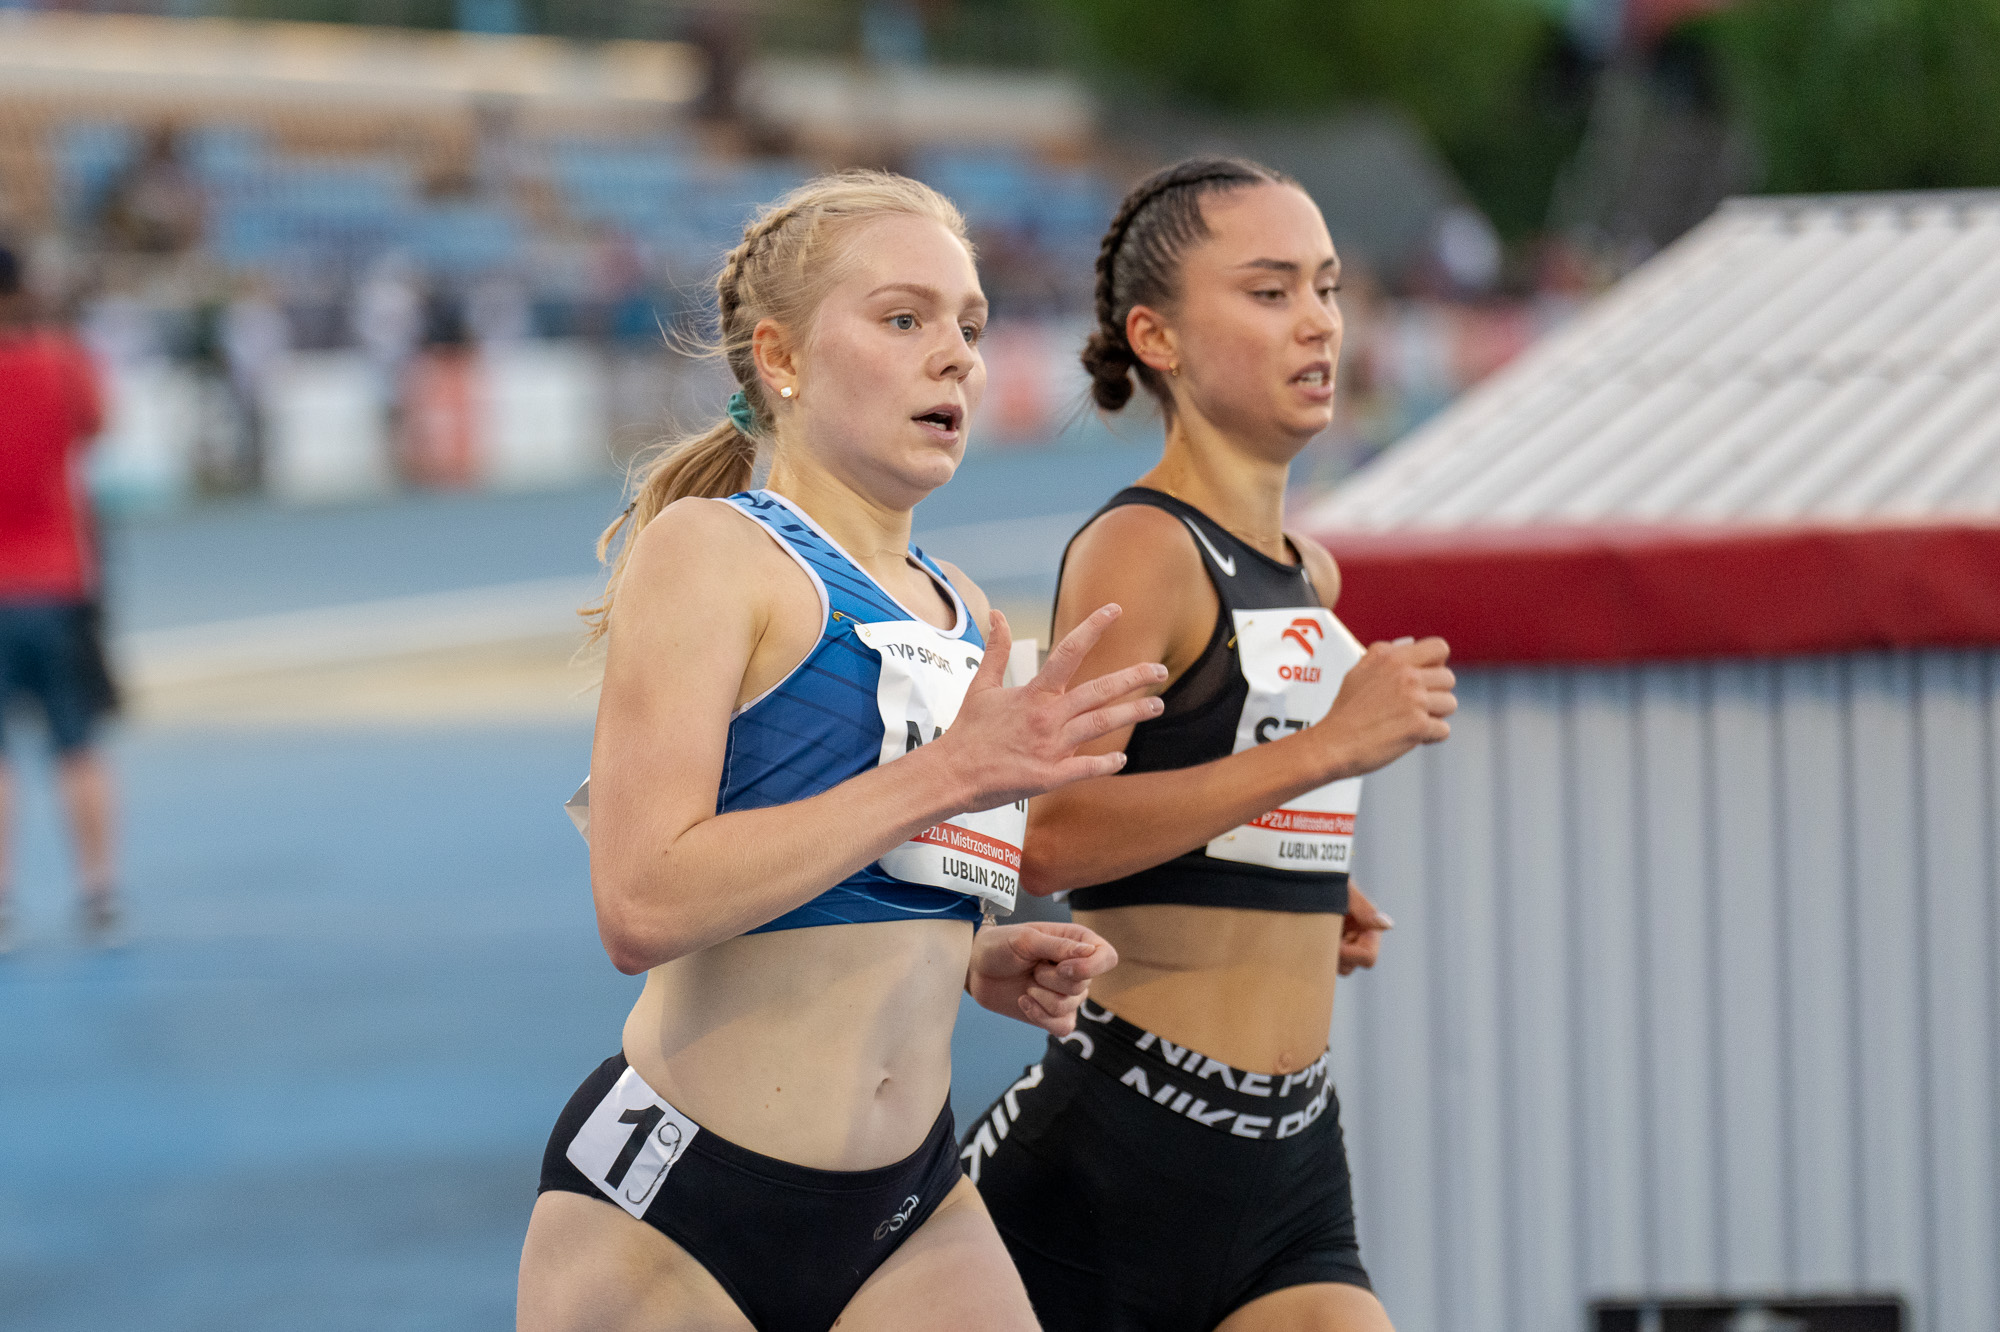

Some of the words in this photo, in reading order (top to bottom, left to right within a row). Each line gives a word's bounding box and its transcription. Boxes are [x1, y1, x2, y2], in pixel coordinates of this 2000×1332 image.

[881, 644, 914, 660] TVP
[917, 646, 953, 675] SPORT
[950, 831, 1004, 861] Mistrzostwa
[1278, 841, 1318, 860] LUBLIN
[1321, 843, 1347, 861] 2023
[943, 856, 988, 887] LUBLIN
[990, 870, 1015, 897] 2023
